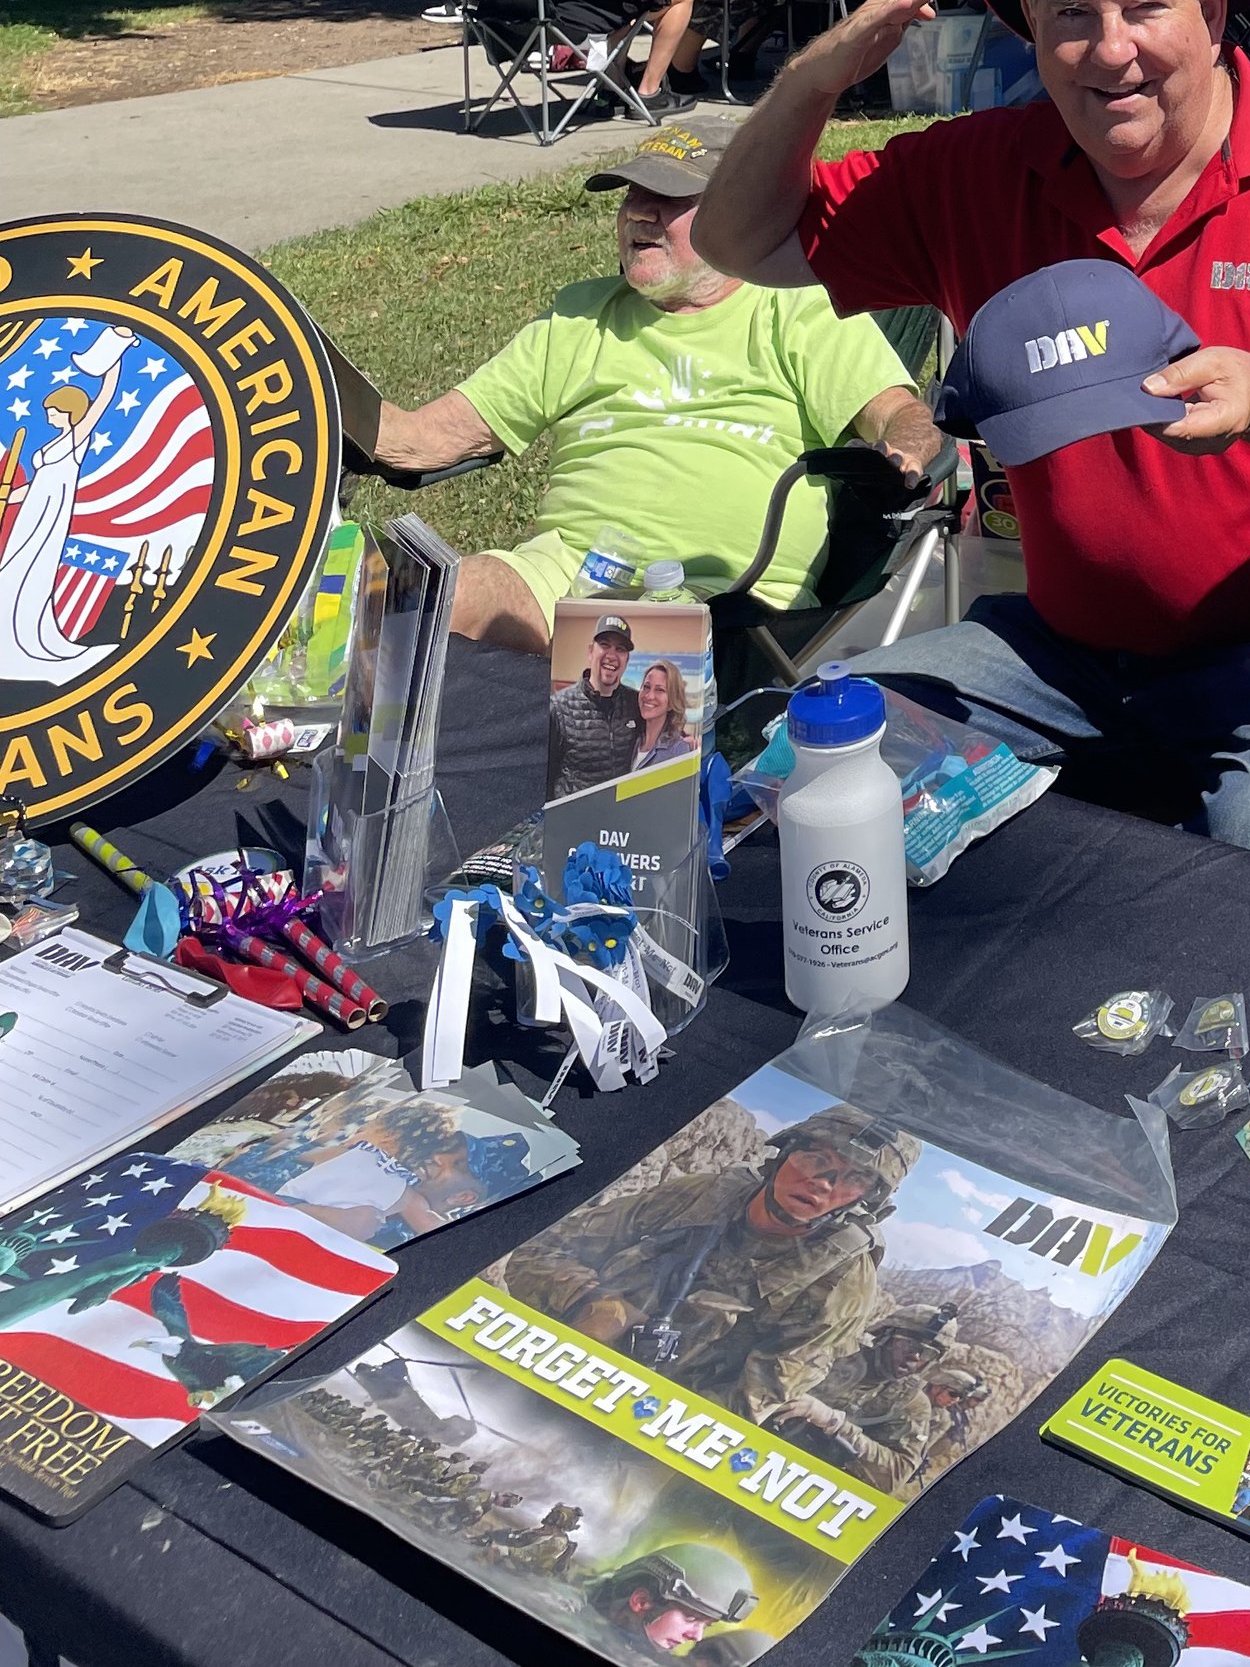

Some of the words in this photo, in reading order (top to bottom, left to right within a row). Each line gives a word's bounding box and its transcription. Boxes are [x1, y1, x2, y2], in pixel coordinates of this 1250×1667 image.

[1025, 320, 1109, 374] DAV
[129, 257, 304, 597] AMERICAN
[600, 830, 630, 848] DAV
[843, 863, 868, 886] ALAMEDA
[792, 919, 843, 939] Veterans
[846, 916, 890, 938] Service
[817, 907, 859, 921] CALIFORNIA
[35, 943, 101, 972] DAV
[820, 944, 860, 955] Office
[982, 1196, 1145, 1277] DAV
[444, 1294, 644, 1416] FORGET
[640, 1399, 739, 1471] ME
[737, 1454, 878, 1540] NOT
[1078, 1397, 1221, 1478] VETERANS
[1098, 1380, 1188, 1436] VICTORIES
[1189, 1423, 1233, 1458] FOR
[3, 1419, 103, 1486] FREE
